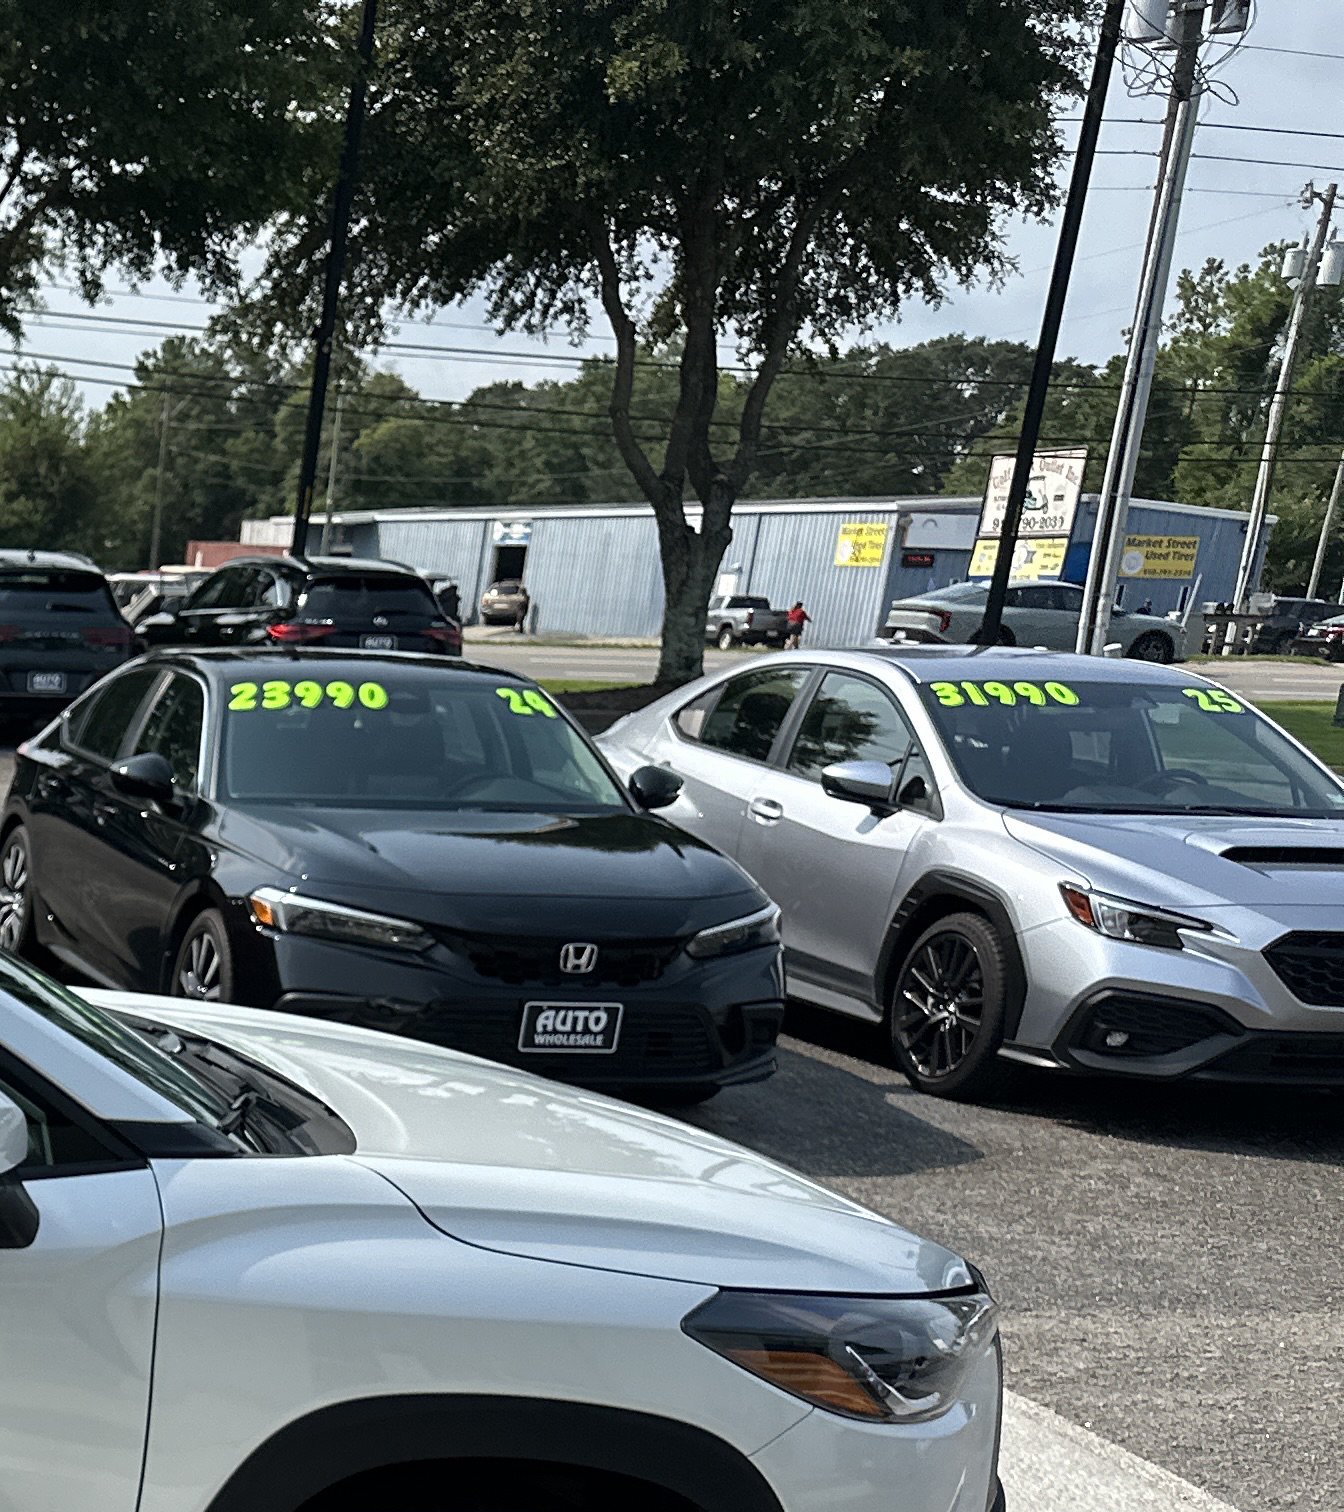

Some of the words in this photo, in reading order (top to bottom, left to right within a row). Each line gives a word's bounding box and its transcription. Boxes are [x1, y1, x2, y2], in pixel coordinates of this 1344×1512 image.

[228, 680, 389, 711] 23990
[930, 682, 1080, 707] 31990
[1182, 687, 1245, 714] 25
[536, 1009, 608, 1033] AUTO
[534, 1033, 604, 1046] WHOLESALE
